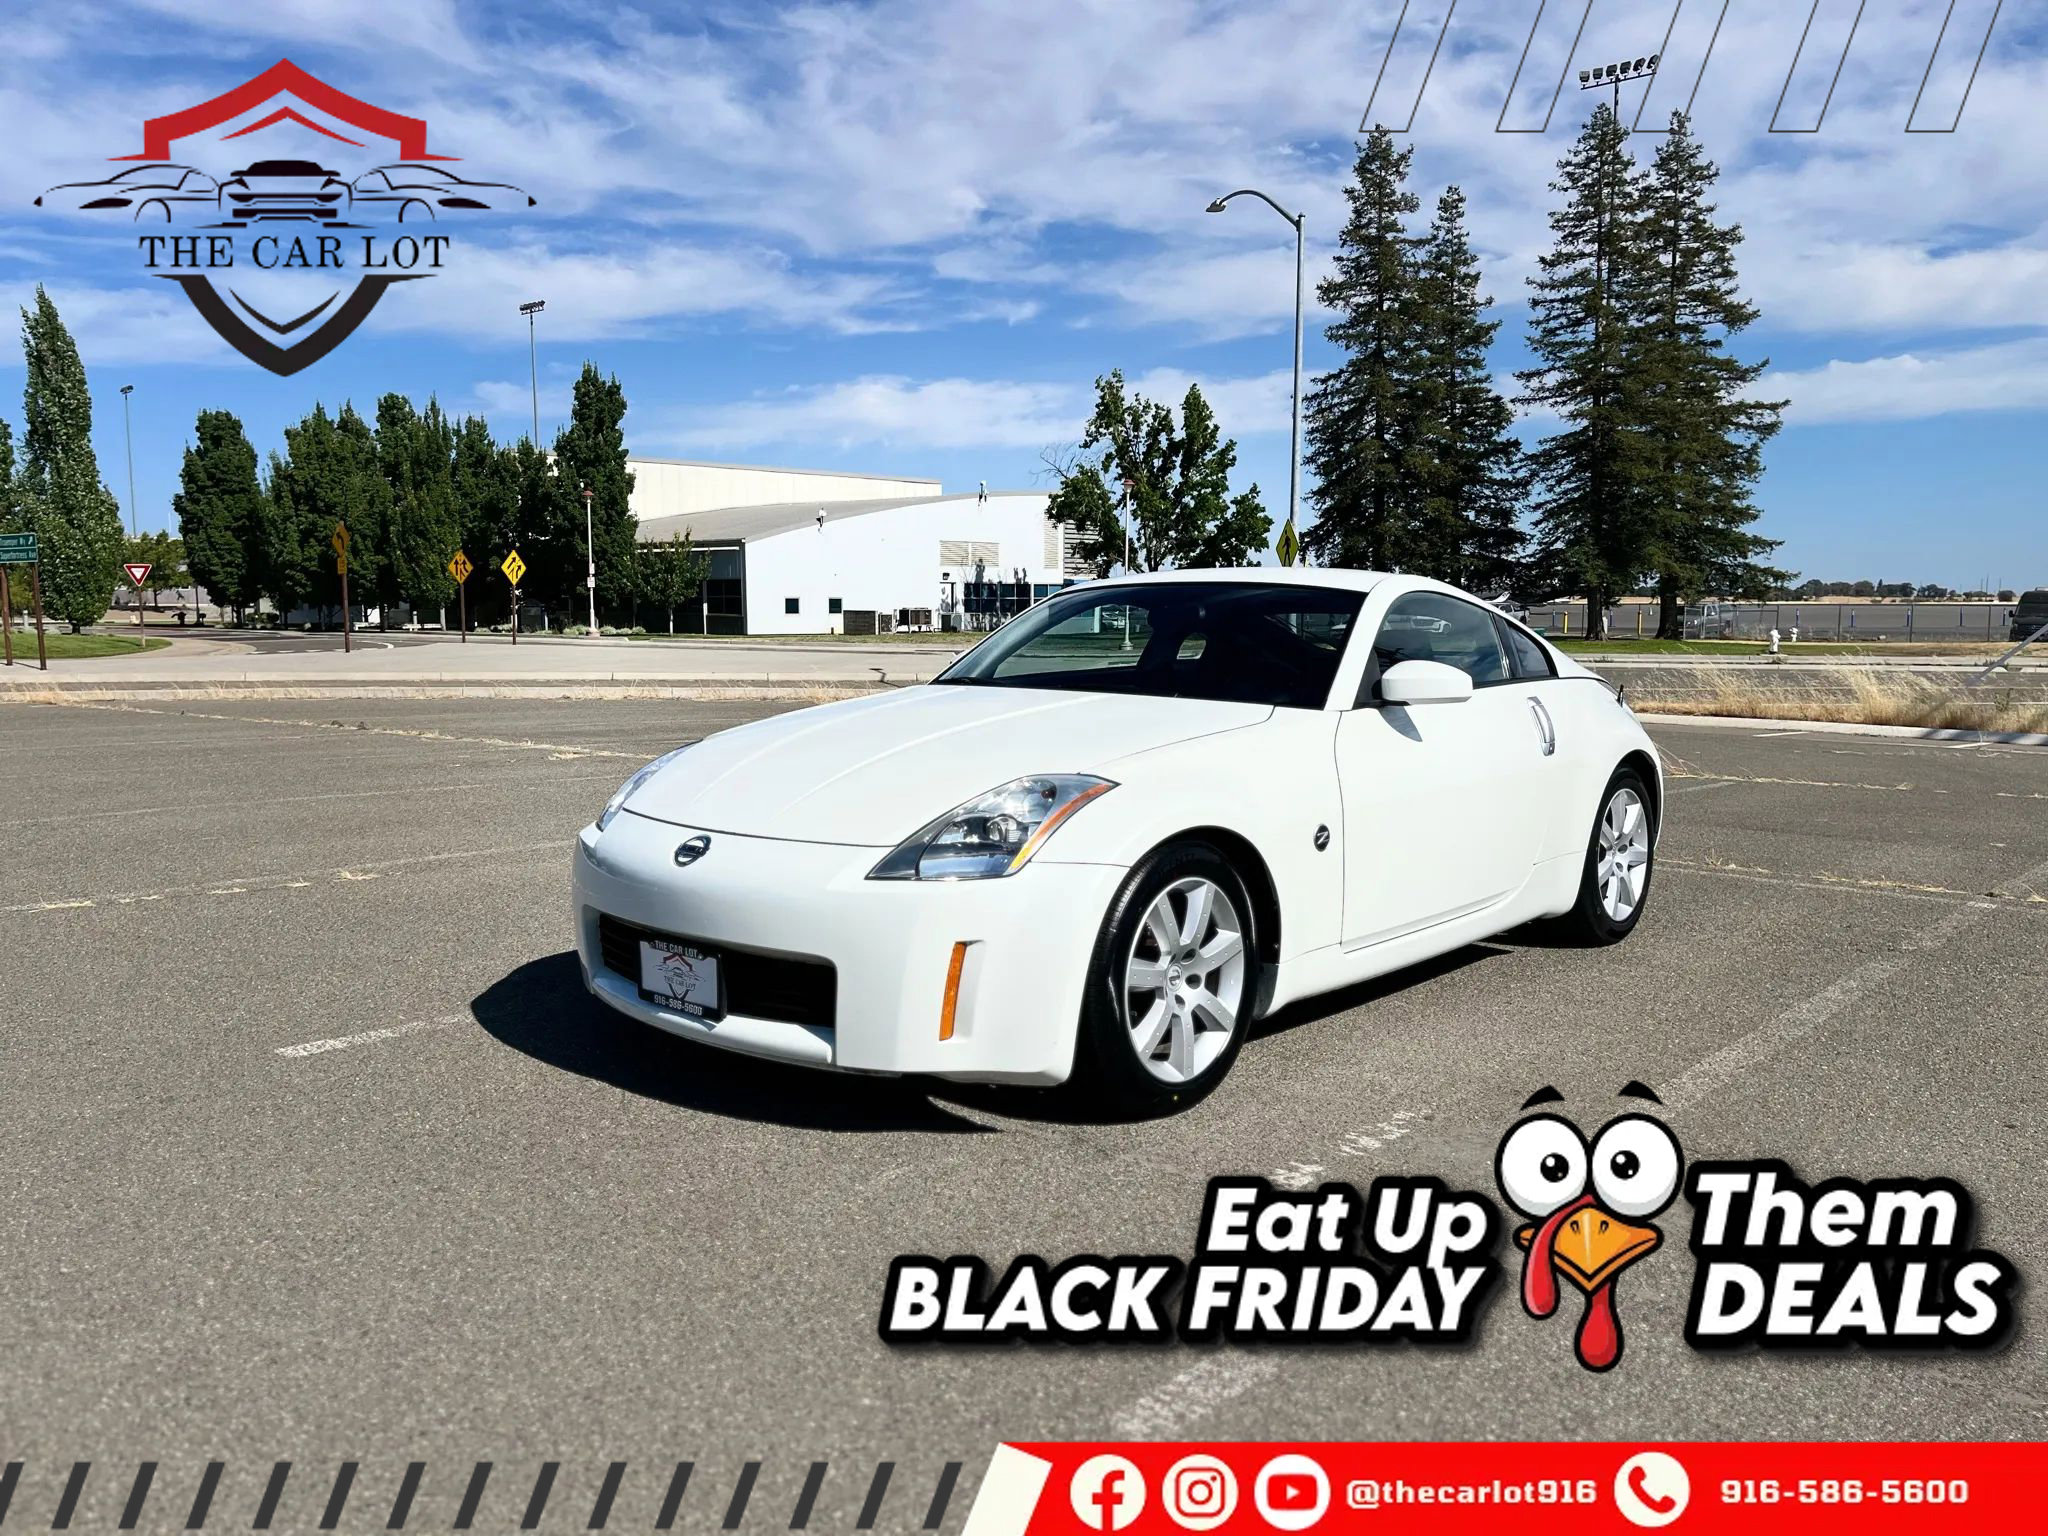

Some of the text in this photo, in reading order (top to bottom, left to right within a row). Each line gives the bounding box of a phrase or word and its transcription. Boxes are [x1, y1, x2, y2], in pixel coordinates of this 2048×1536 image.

[655, 940, 698, 957] THE CAR LOT
